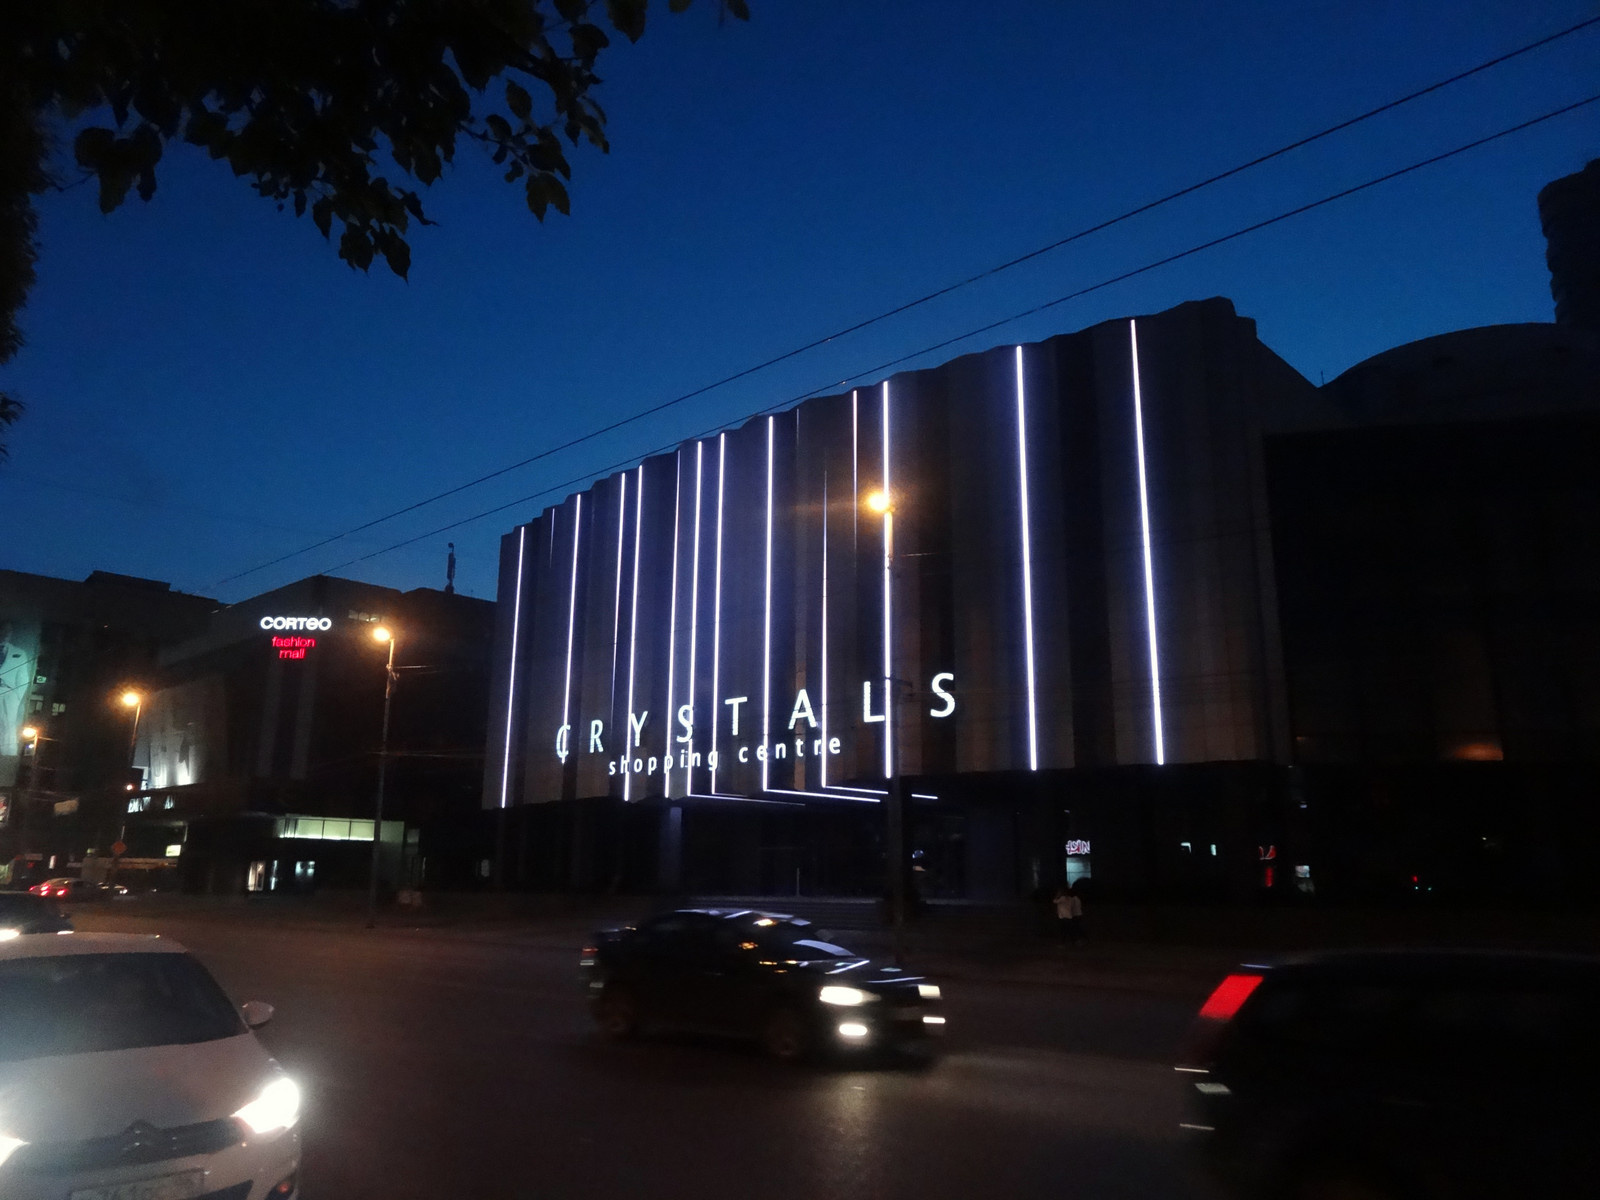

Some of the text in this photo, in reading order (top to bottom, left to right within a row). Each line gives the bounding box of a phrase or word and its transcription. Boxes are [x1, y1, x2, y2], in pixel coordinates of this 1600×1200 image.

[271, 635, 317, 648] fashion
[279, 647, 306, 660] mall
[555, 671, 957, 758] CRYSTALS
[608, 736, 842, 776] shopping centre
